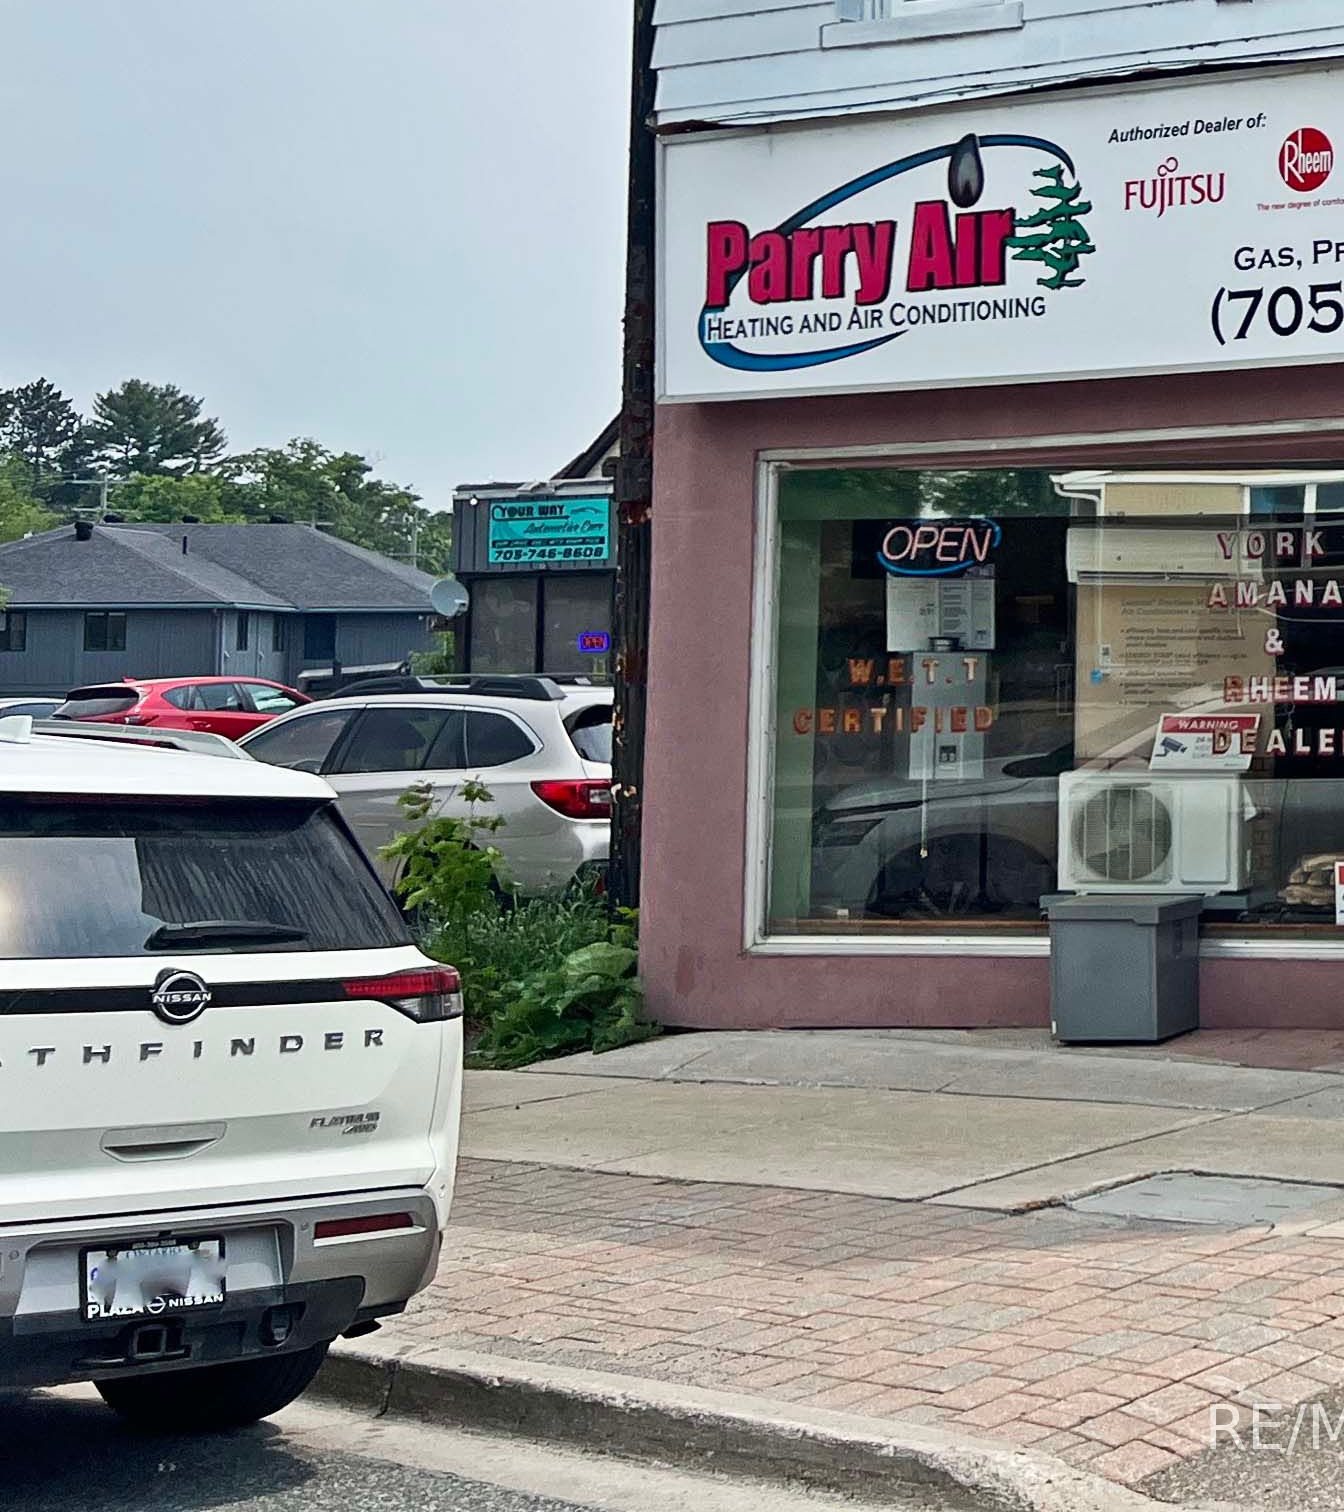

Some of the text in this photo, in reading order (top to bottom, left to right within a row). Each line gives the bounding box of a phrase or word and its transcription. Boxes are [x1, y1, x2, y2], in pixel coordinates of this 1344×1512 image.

[1107, 113, 1267, 144] Authorized Dealer of:
[1284, 128, 1333, 184] Rheem
[1123, 168, 1226, 217] FUJITSU
[1256, 203, 1269, 211] The
[1287, 200, 1311, 211] degree
[1313, 199, 1321, 207] of
[705, 199, 1017, 307] Parry Air
[882, 524, 993, 563] OPEN
[1217, 530, 1327, 561] YORK
[1207, 579, 1344, 608] AMANA
[1263, 627, 1284, 656] &
[1223, 675, 1338, 706] RHEEM
[792, 704, 996, 736] CERTIFIED
[1177, 719, 1239, 730] WARNING
[152, 991, 212, 1004] NISSAN
[0, 1029, 385, 1067] THFINDER
[87, 1293, 224, 1319] PLAZA NISSAN
